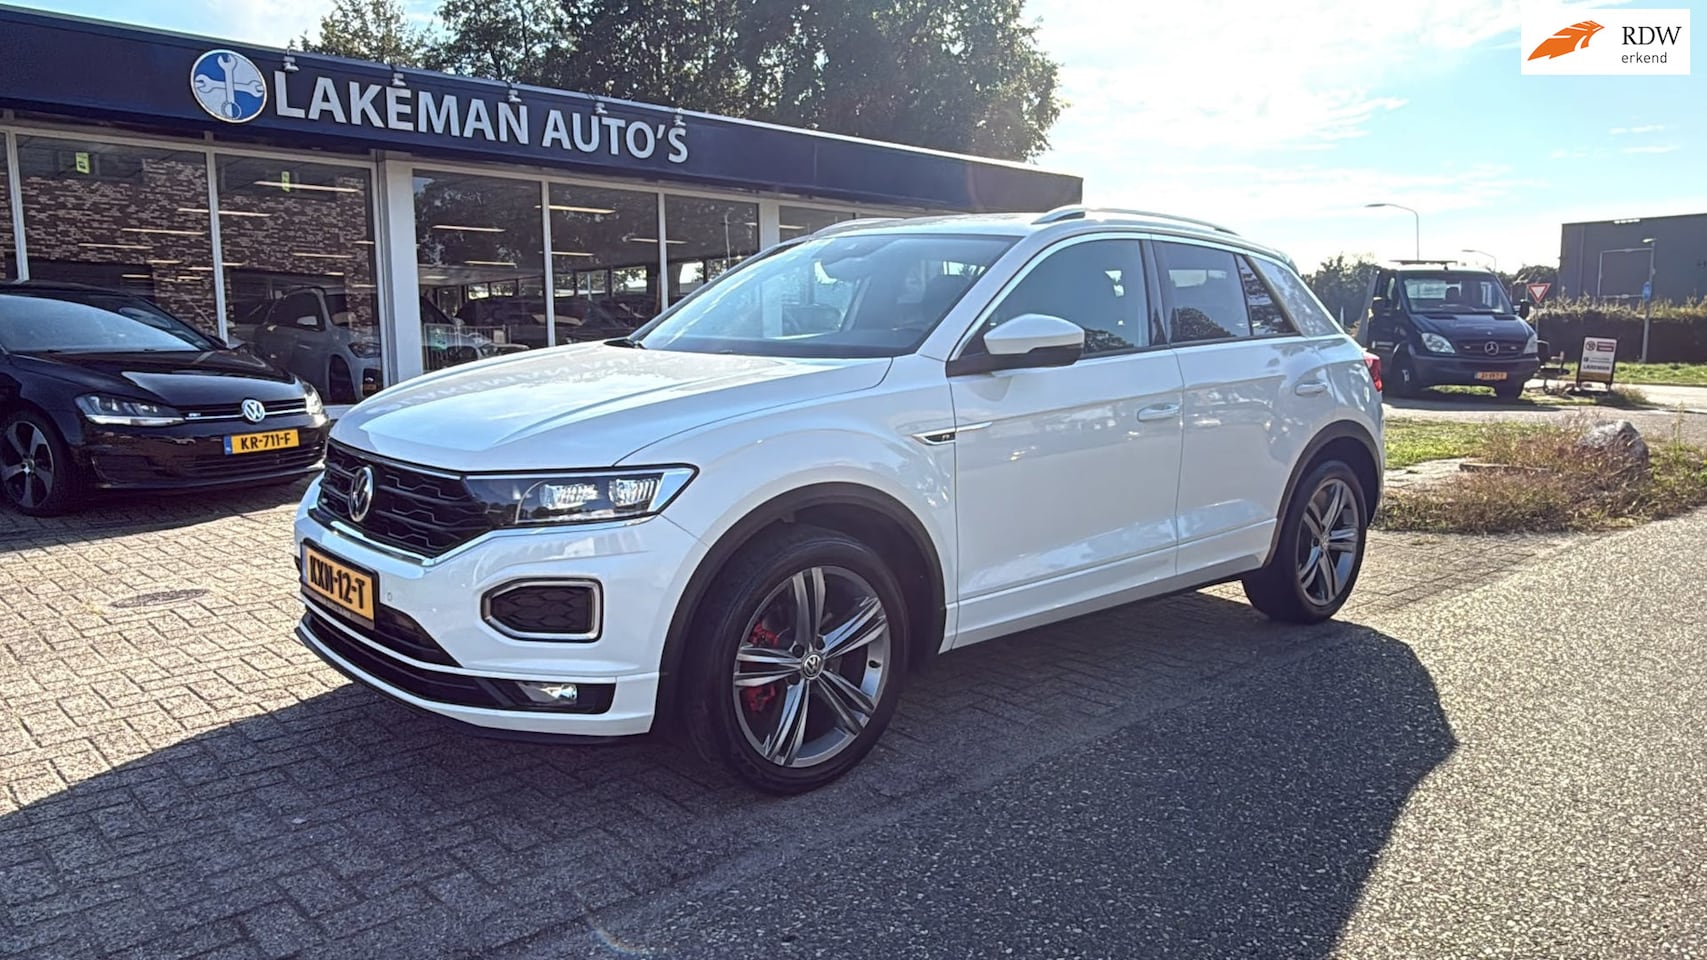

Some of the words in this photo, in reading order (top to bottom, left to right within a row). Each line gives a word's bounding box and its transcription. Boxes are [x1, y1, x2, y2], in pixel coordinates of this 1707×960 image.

[274, 70, 529, 145] LAKEMAN
[542, 109, 689, 164] AUTO'S
[241, 399, 266, 422] VW
[240, 432, 291, 450] KR-711-F
[310, 554, 366, 610] KXN-12-T
